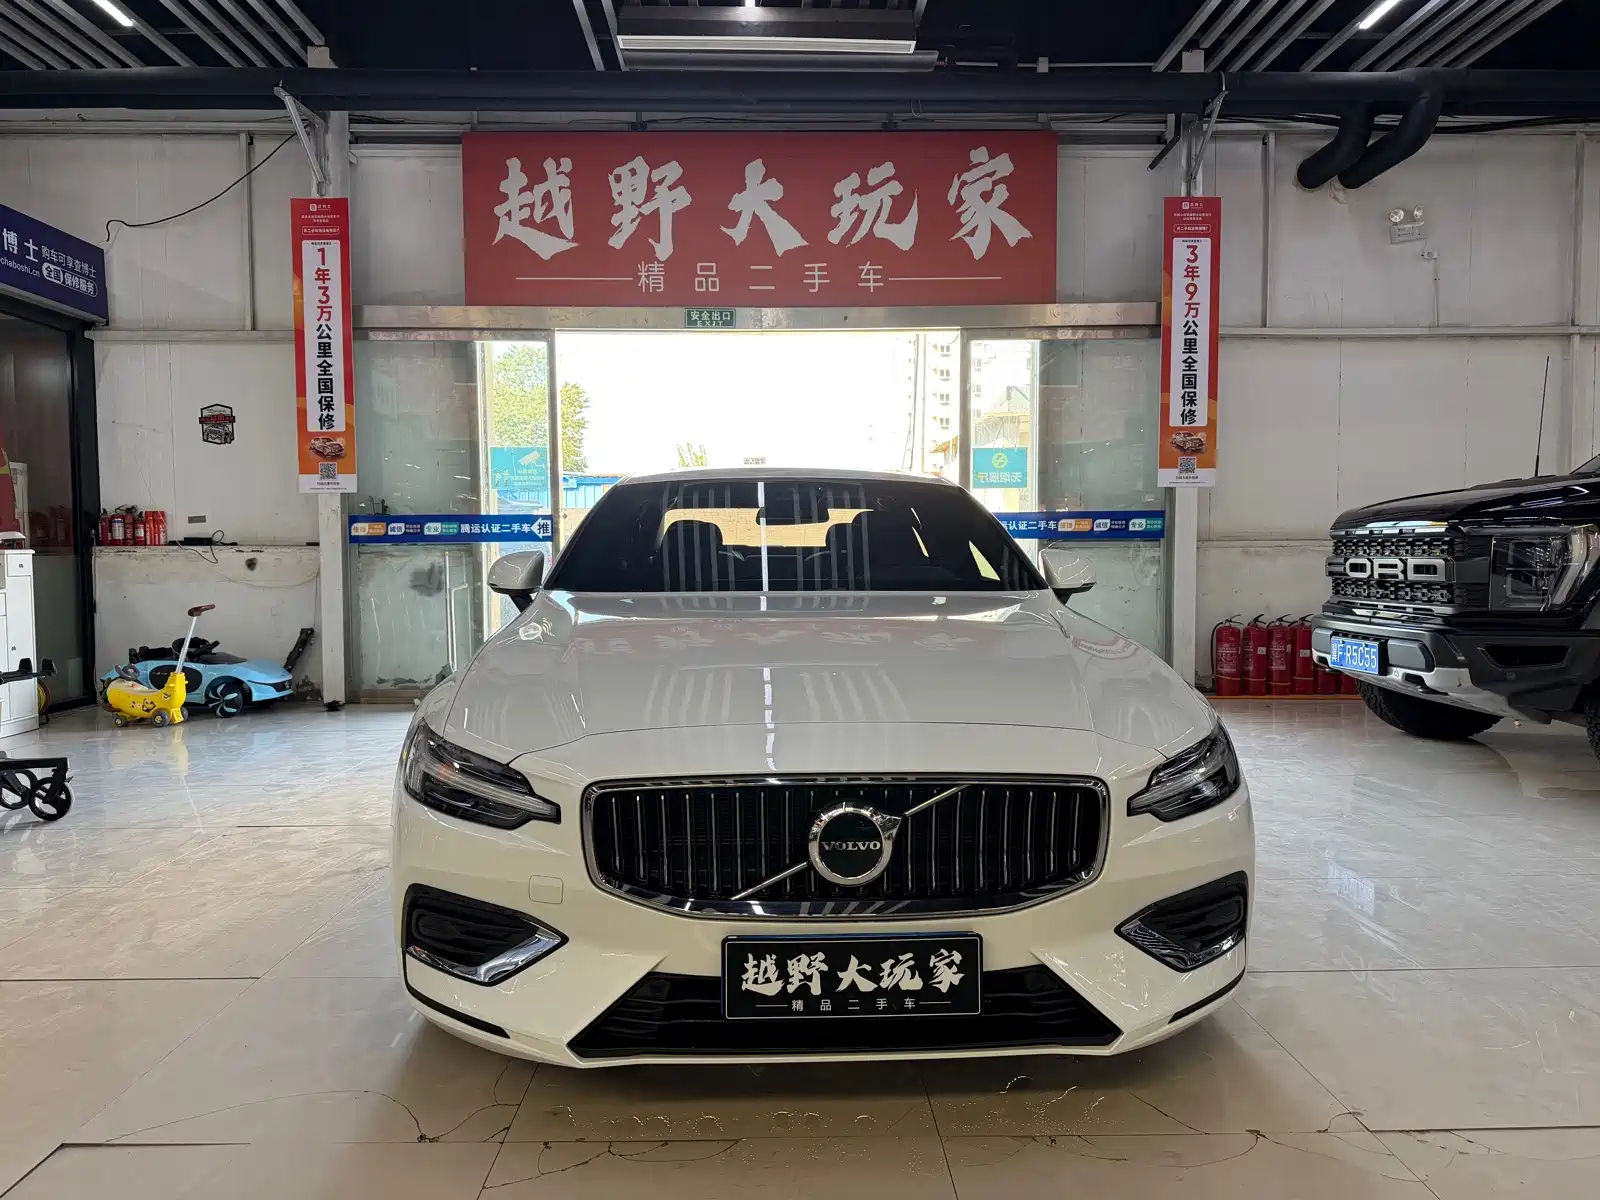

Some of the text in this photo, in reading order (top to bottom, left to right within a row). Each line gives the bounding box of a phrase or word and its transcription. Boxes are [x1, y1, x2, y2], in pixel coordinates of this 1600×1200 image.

[492, 146, 1033, 261] 越野大玩家
[2, 228, 39, 262] 博士
[41, 245, 97, 278] 购车可享查博士
[637, 260, 884, 293] 精品二手车
[690, 310, 731, 321] 安全出口
[697, 320, 724, 328] EXIT
[314, 247, 335, 430] 1年3万公里全国保修
[1180, 244, 1201, 425] 3年9万公里全国保修
[537, 521, 551, 535] 推
[820, 841, 881, 851] VOLVO
[741, 948, 966, 996] 越野大玩家
[791, 997, 916, 1012] 精品二手车
